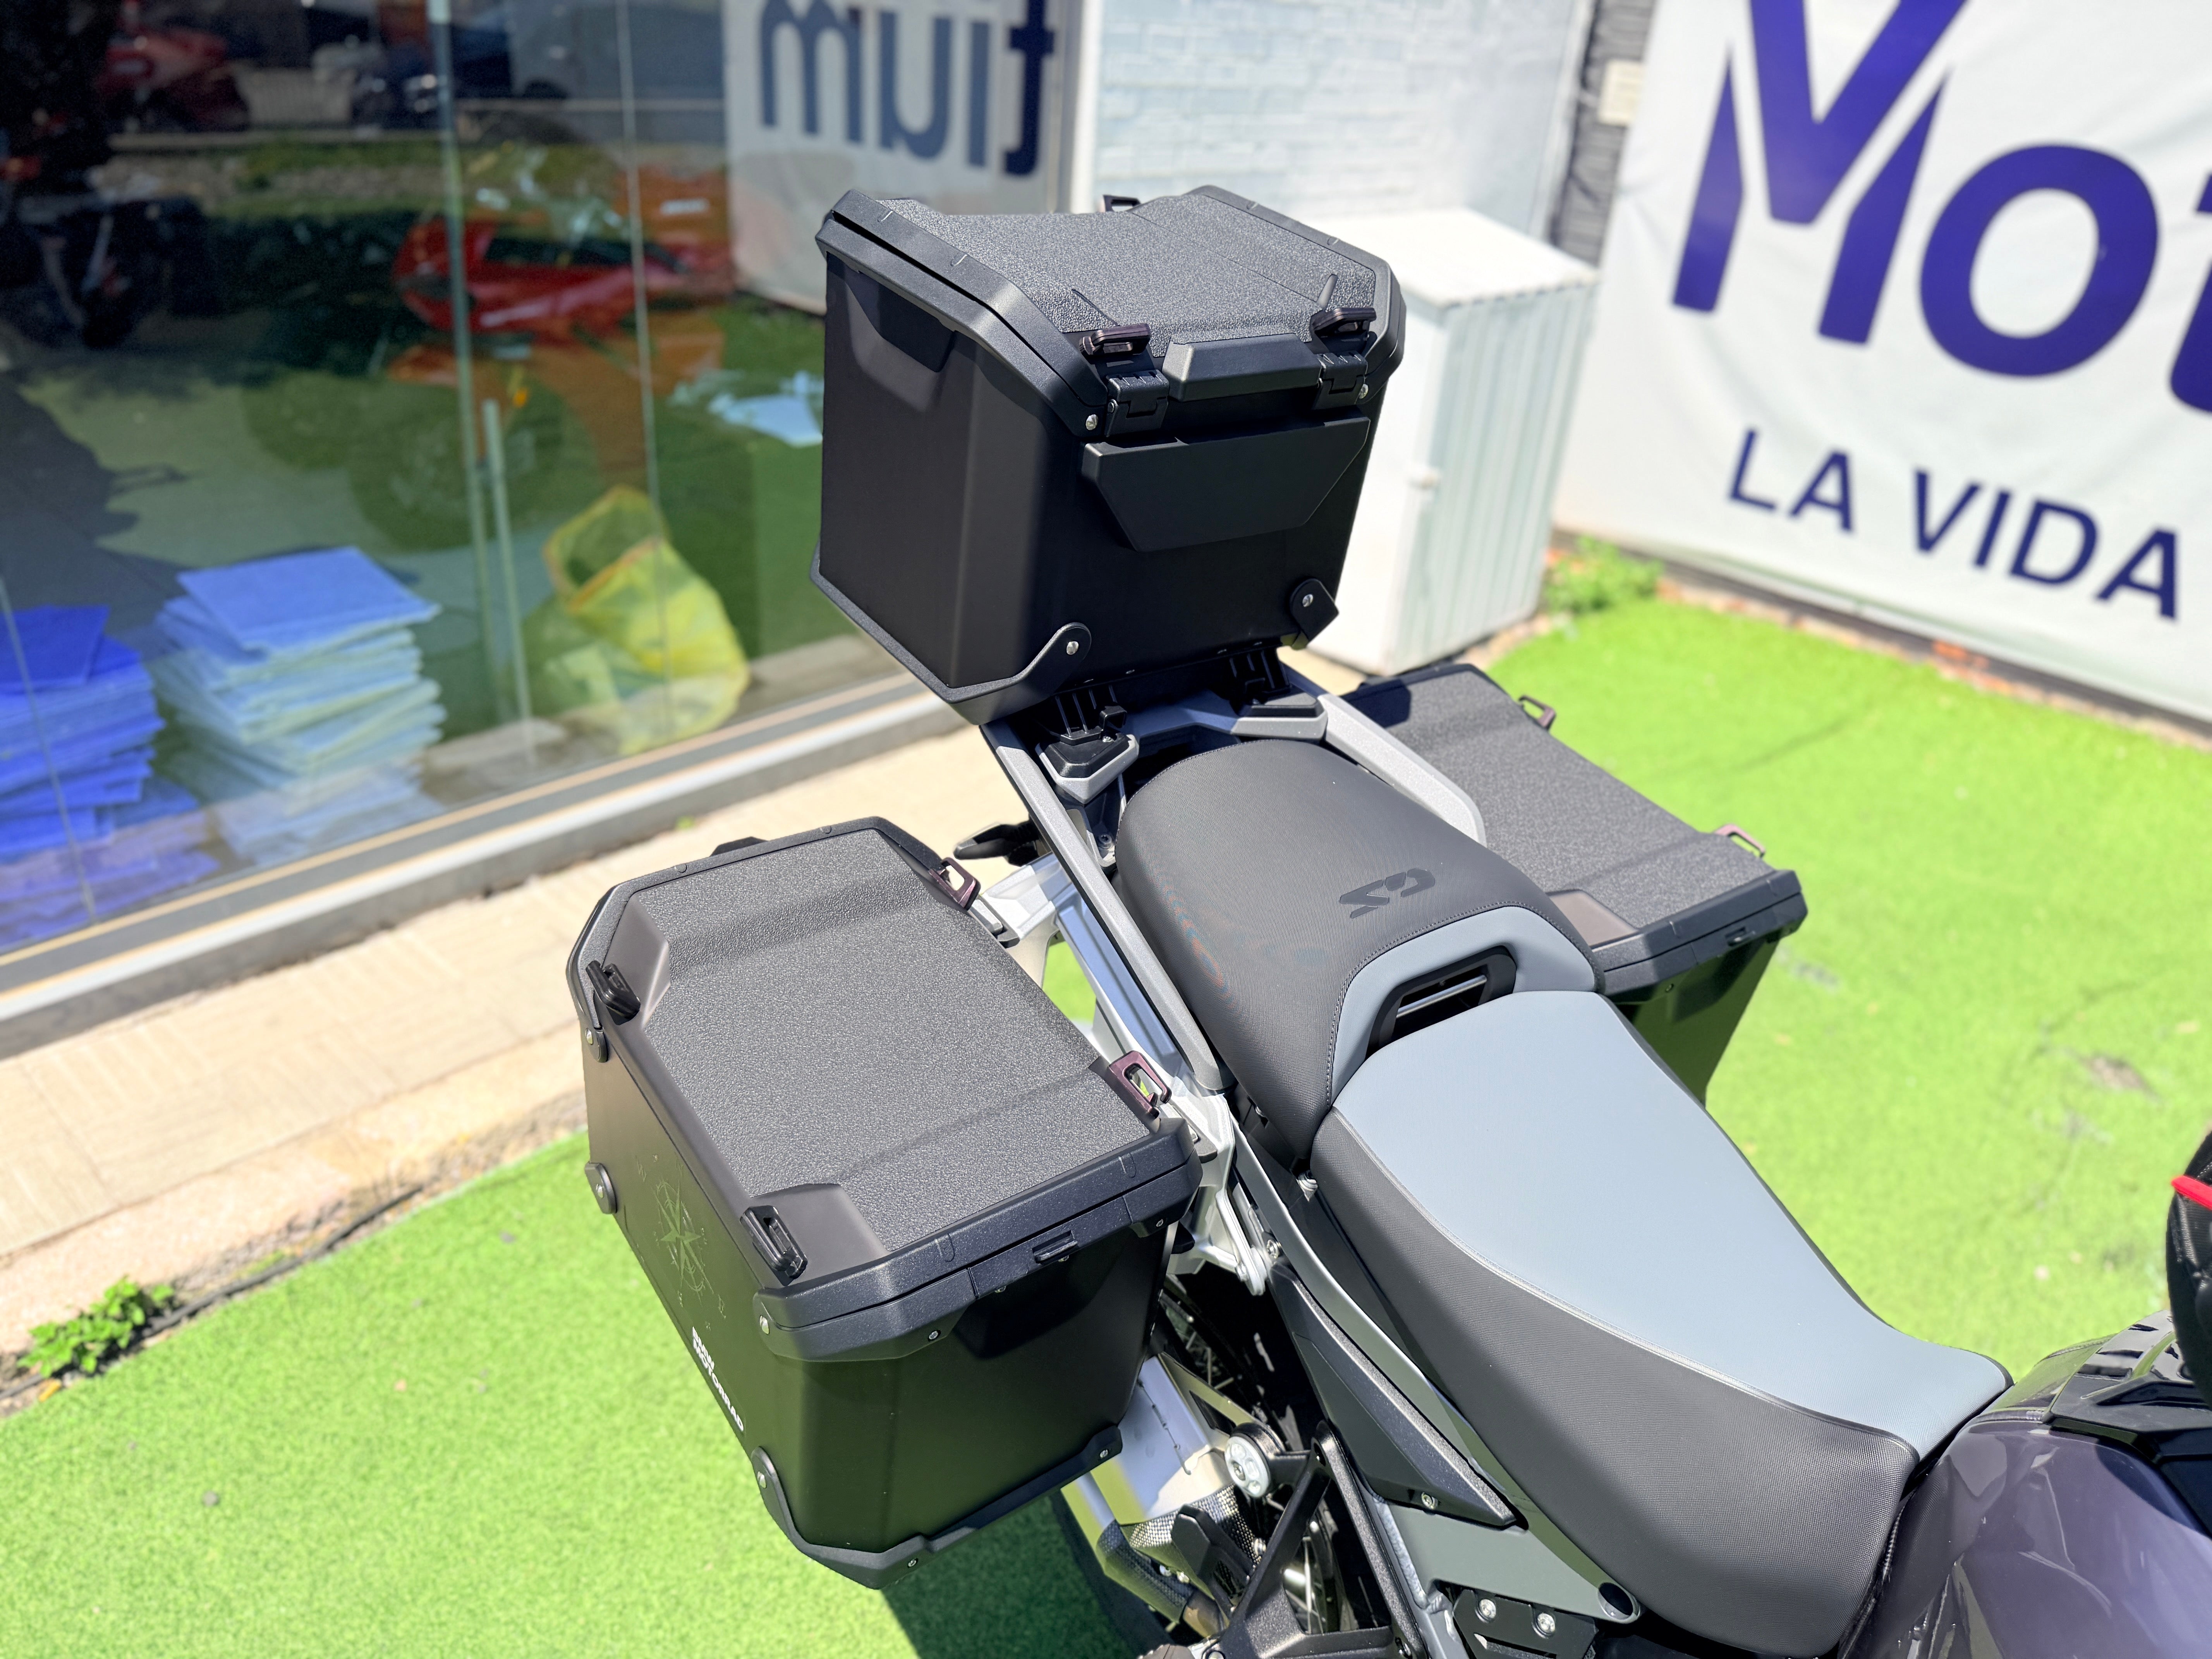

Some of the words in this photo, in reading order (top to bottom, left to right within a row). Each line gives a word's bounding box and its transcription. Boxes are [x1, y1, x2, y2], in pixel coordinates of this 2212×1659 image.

[1728, 429, 1853, 533] LA
[1914, 469, 2178, 621] VIDA
[692, 1326, 715, 1370] BMW
[693, 1338, 744, 1432] MOTORRAD
